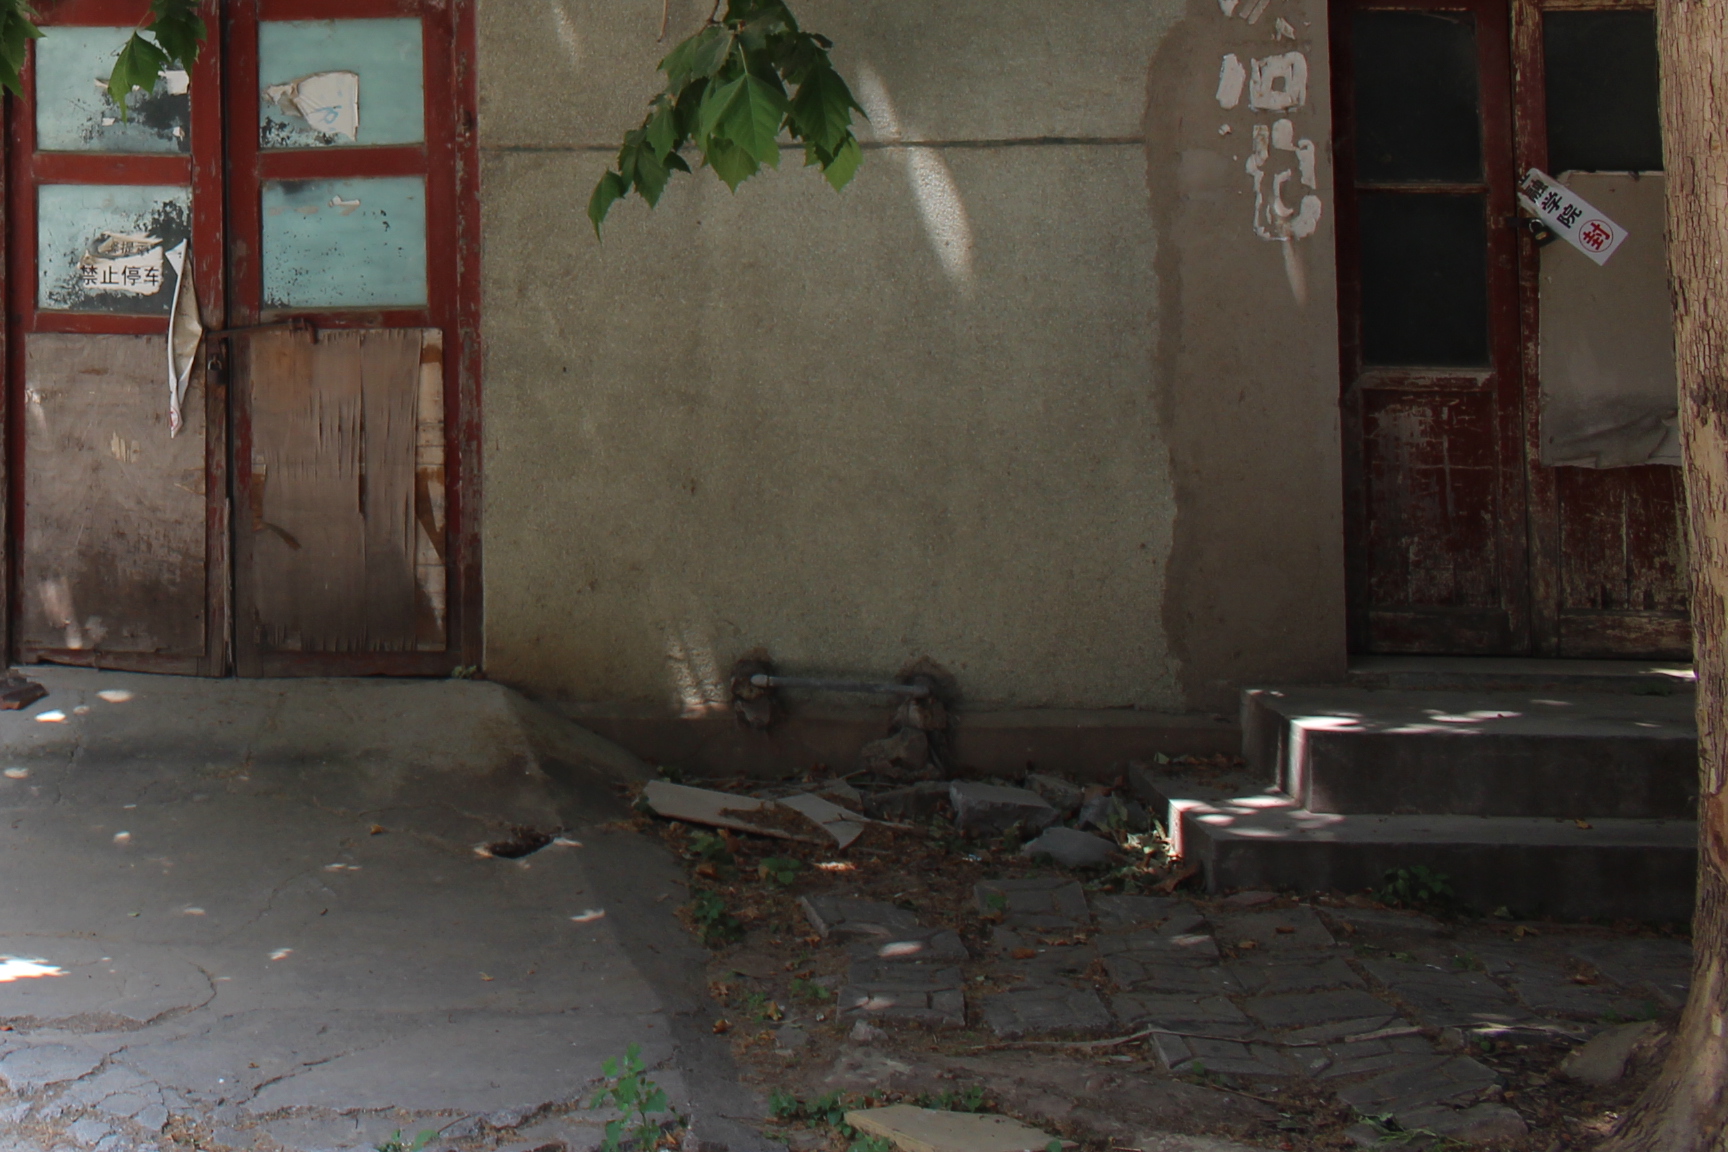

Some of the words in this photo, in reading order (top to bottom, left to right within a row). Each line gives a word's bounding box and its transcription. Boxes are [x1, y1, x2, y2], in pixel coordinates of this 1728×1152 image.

[1581, 222, 1611, 251] 封
[80, 264, 160, 286] 禁止停车
